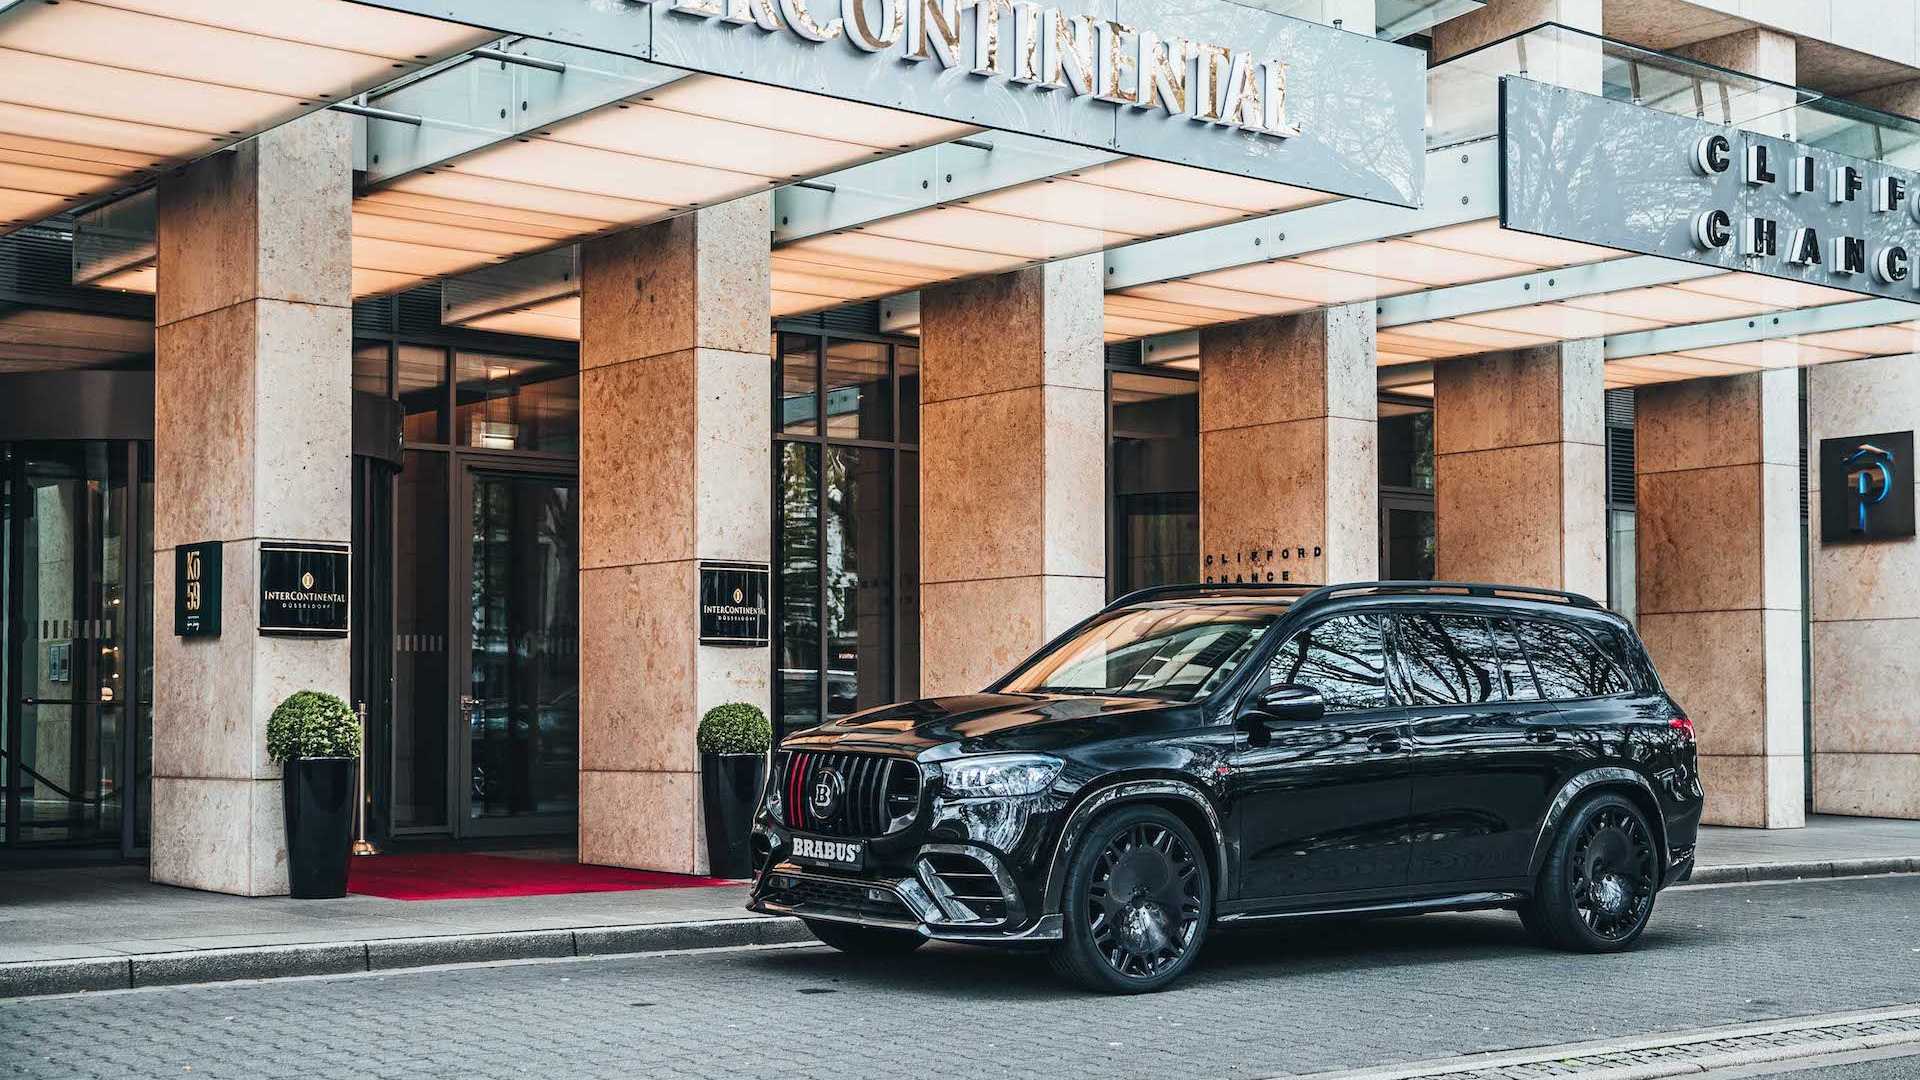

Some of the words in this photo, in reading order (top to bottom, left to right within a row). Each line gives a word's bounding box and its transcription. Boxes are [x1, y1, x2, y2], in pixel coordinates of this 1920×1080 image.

[1697, 133, 1920, 224] CLIFF
[1697, 208, 1920, 286] CHANC
[1206, 546, 1321, 565] CLIFFORD
[1206, 570, 1290, 584] CHANCE
[186, 581, 201, 611] 59
[815, 783, 831, 807] B
